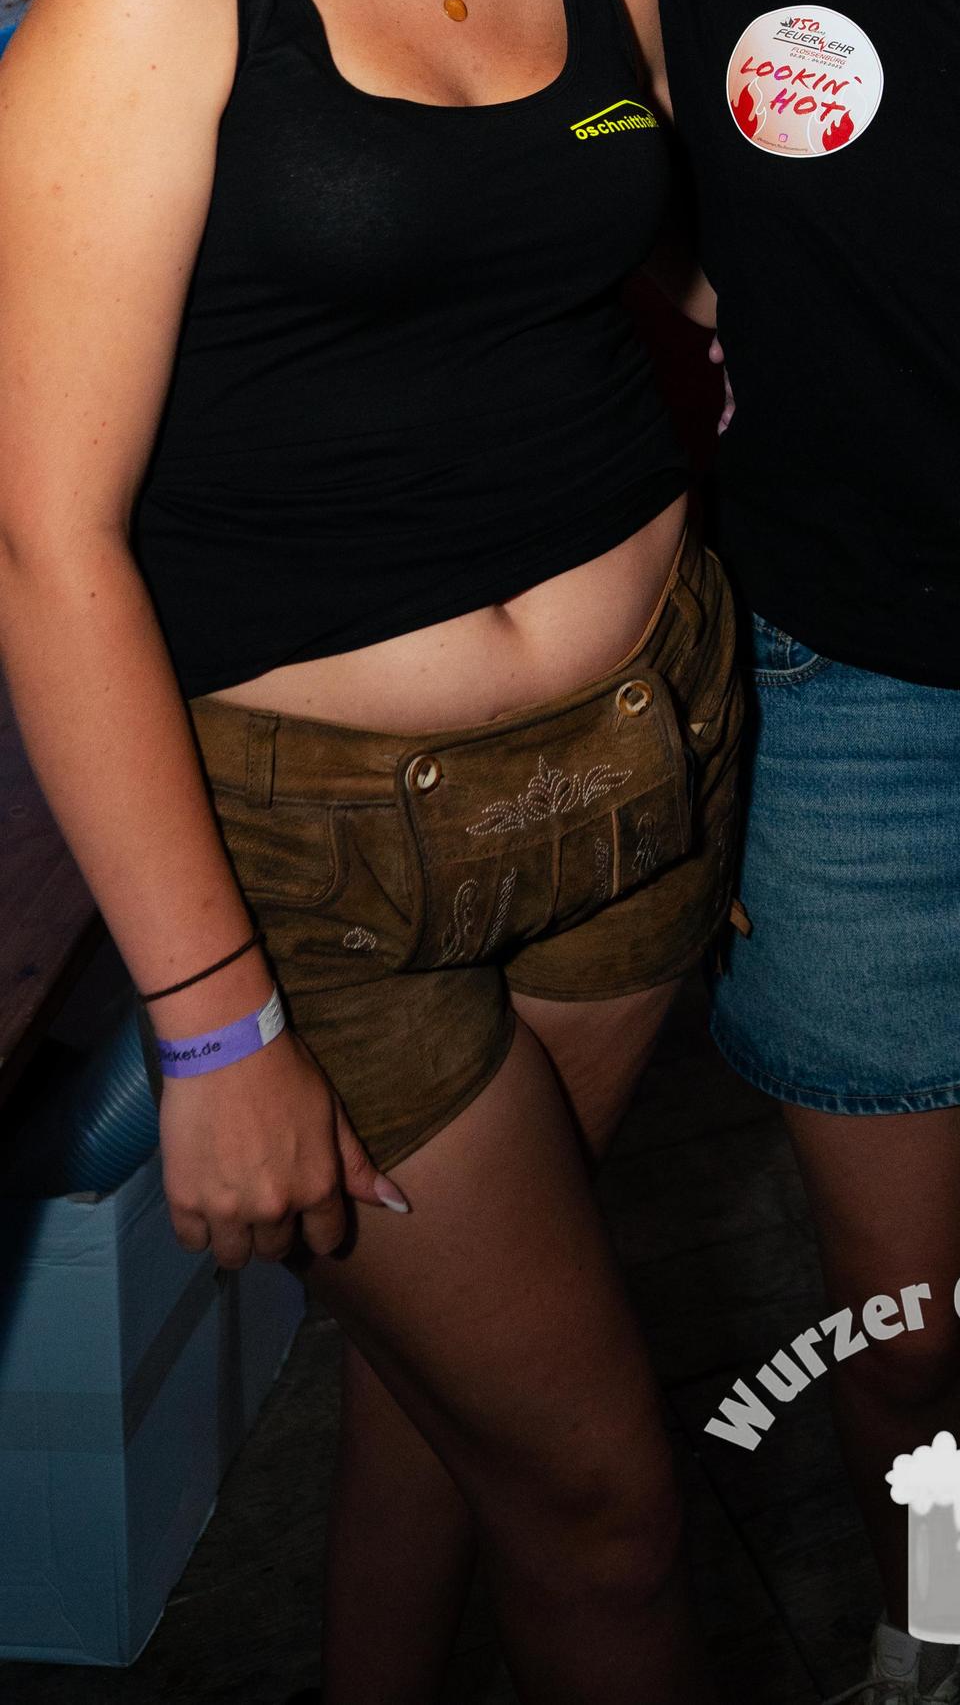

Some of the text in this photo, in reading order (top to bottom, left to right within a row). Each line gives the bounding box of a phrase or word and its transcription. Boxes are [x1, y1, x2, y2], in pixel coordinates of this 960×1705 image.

[791, 17, 820, 32] 150
[775, 28, 855, 54] FEUERWEHR
[769, 88, 846, 122] HOT
